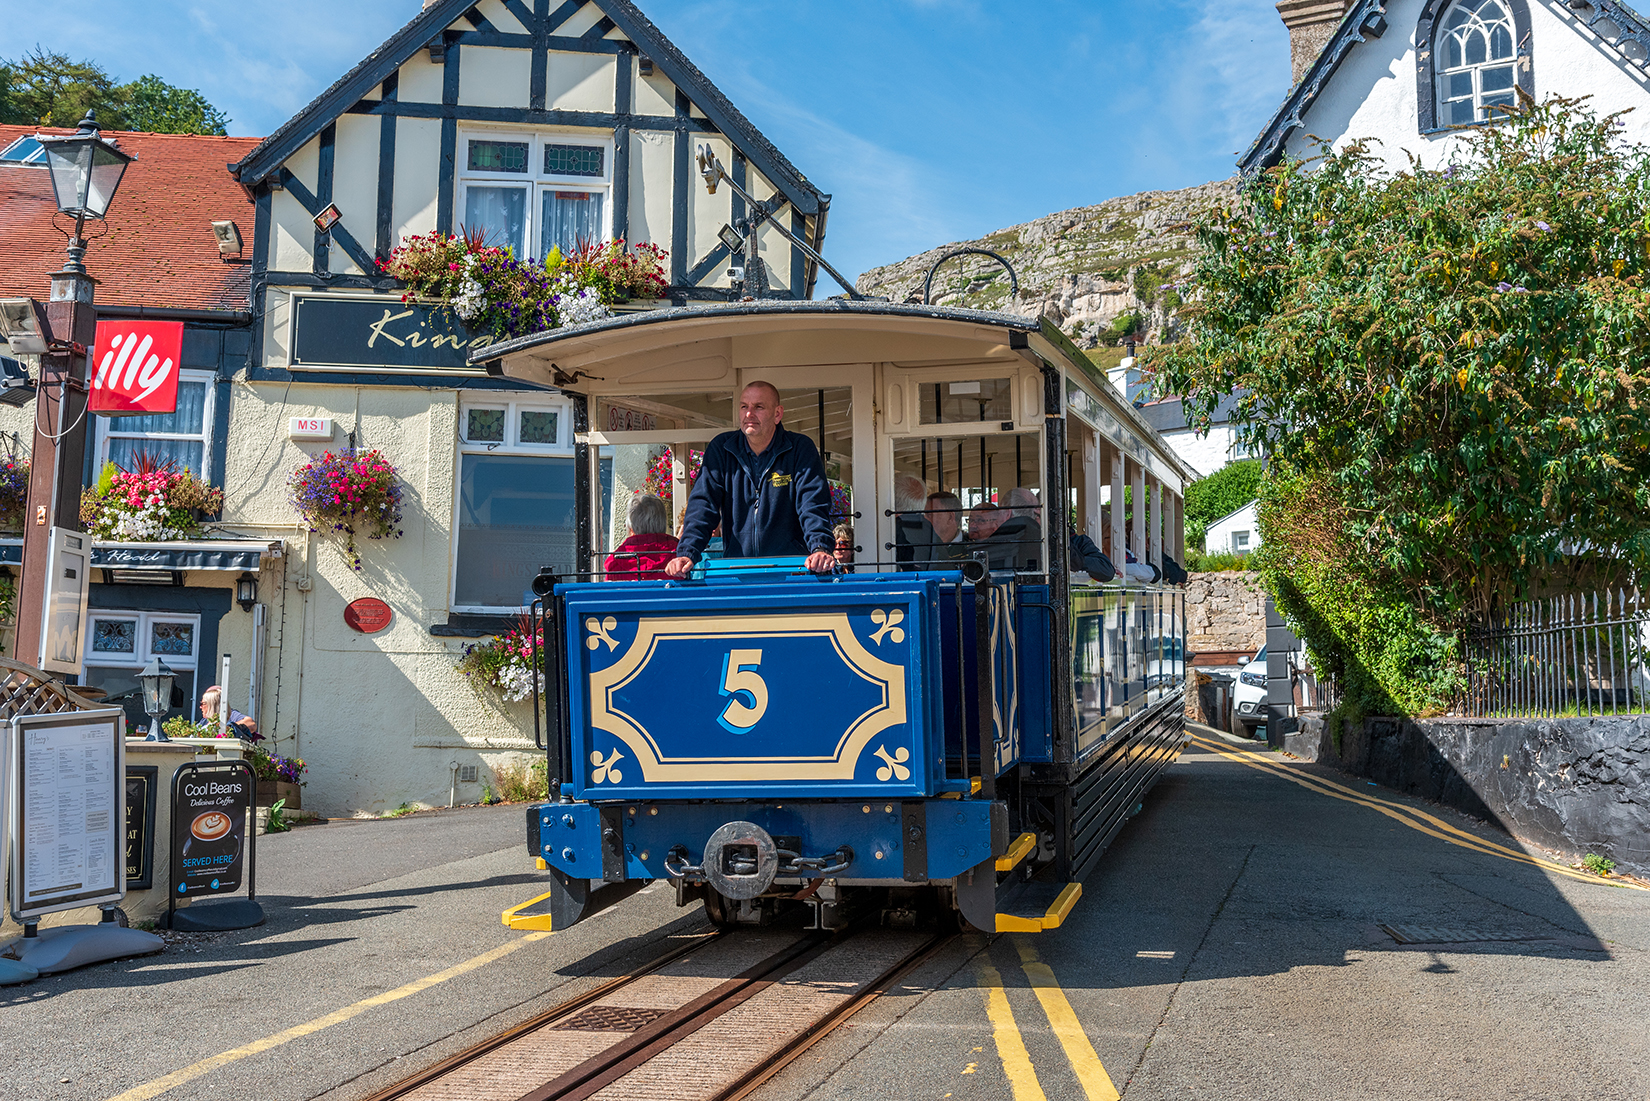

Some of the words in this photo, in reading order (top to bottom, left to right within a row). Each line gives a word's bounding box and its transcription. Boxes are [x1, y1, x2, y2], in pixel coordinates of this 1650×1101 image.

[93, 332, 173, 403] illy
[298, 420, 324, 431] MSI
[716, 649, 769, 734] 5
[185, 782, 208, 796] Cool
[210, 782, 242, 795] Beans
[190, 798, 215, 807] Delicious
[216, 796, 235, 807] Coffee
[182, 856, 212, 868] SERVED
[212, 854, 233, 864] HERE
